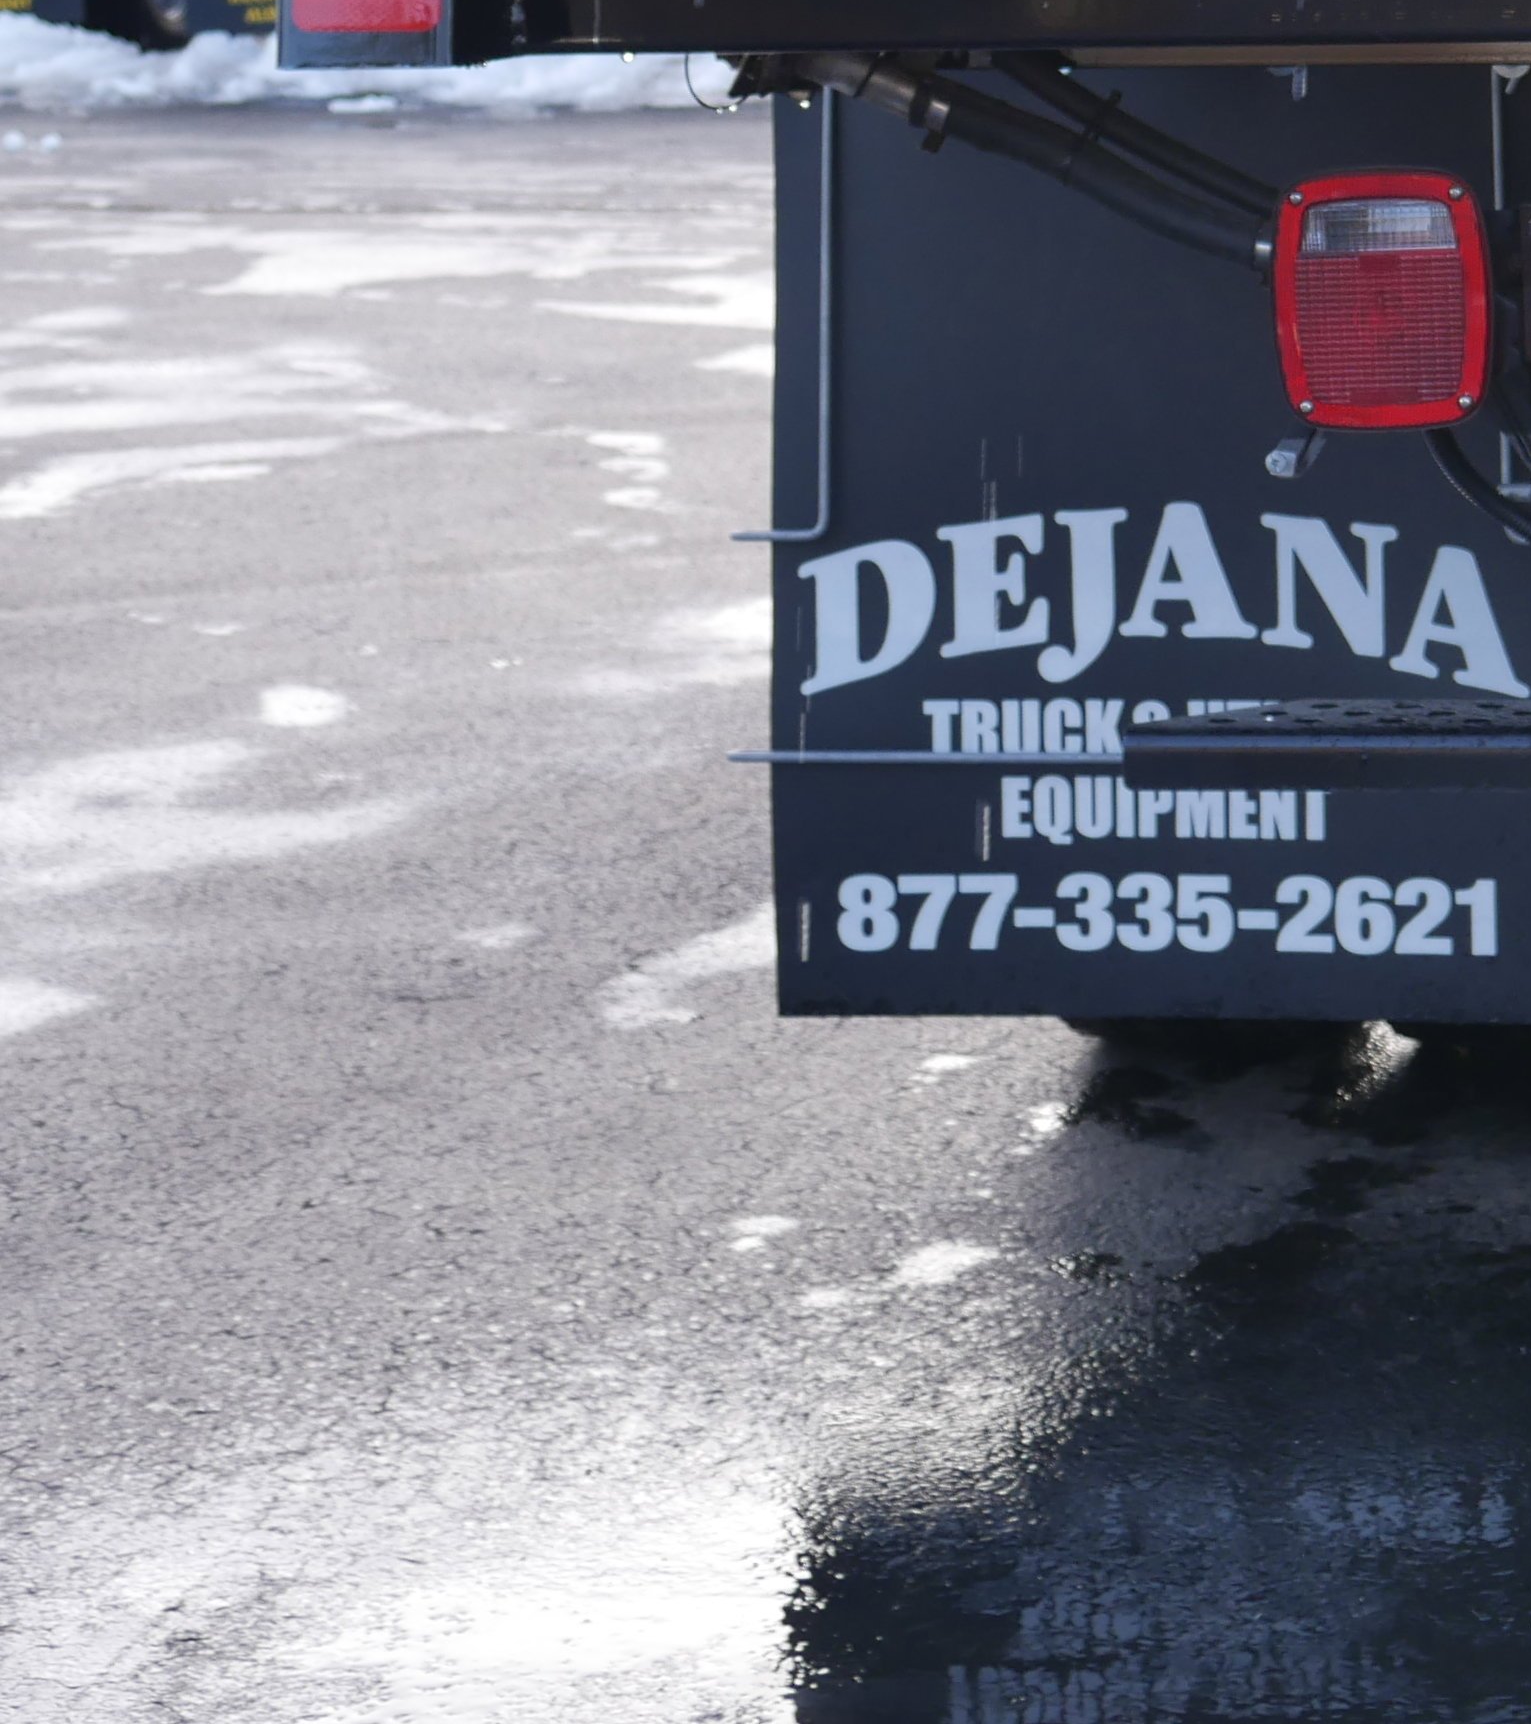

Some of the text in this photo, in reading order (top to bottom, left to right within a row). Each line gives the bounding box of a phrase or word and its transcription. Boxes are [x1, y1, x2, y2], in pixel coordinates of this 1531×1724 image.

[797, 500, 1531, 698] DEJANA
[922, 698, 1125, 754] TRUCK
[1001, 775, 1331, 846] EQUIPMENT
[836, 872, 1499, 957] 877-335-2621
